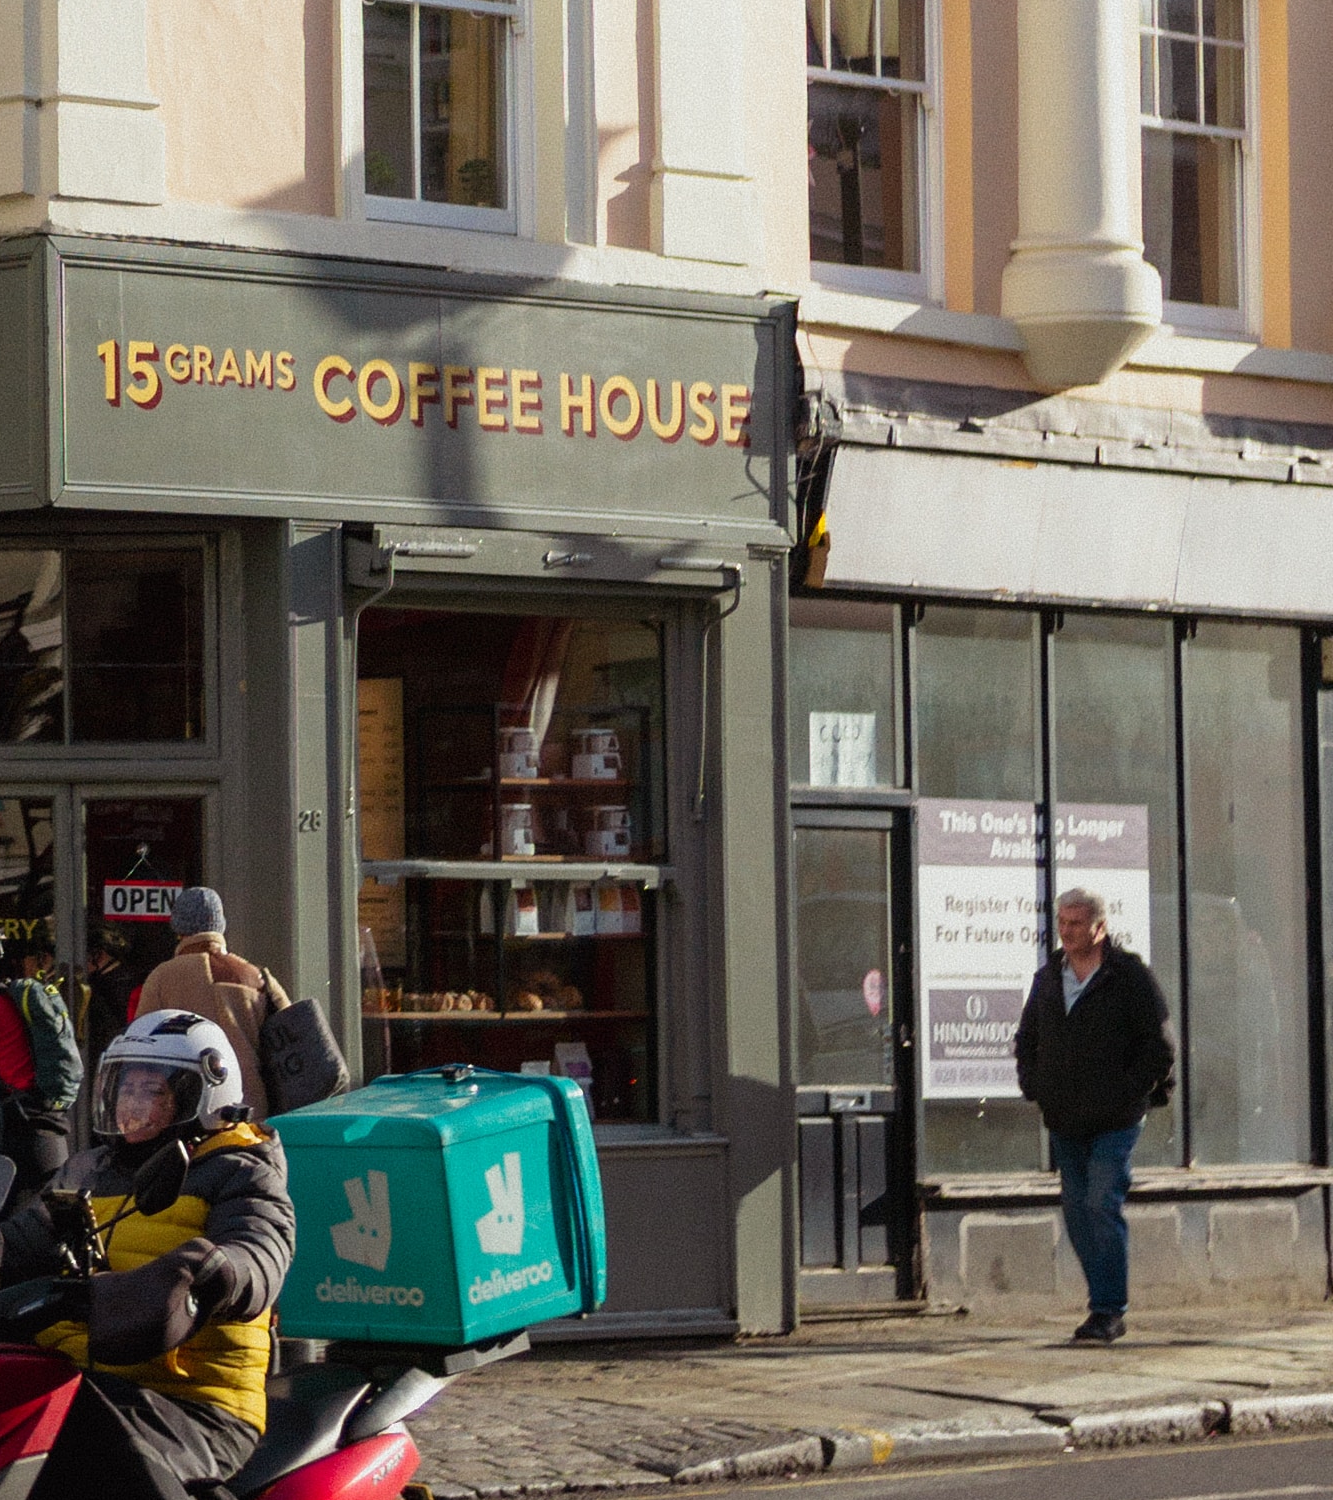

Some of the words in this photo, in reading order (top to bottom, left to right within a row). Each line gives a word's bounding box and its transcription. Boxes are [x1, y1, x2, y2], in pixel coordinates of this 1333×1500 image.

[98, 339, 163, 408] 15
[164, 342, 297, 391] GRAMS
[312, 354, 544, 433] COFFEE
[559, 371, 752, 448] HOUSE
[939, 811, 977, 833] This
[1068, 815, 1126, 842] Longer
[112, 887, 176, 913] OPEN
[945, 896, 1009, 918] Register
[936, 926, 959, 943] For
[965, 926, 1014, 943] Future
[315, 1276, 425, 1307] deliveroo
[468, 1260, 553, 1305] deliveroo
